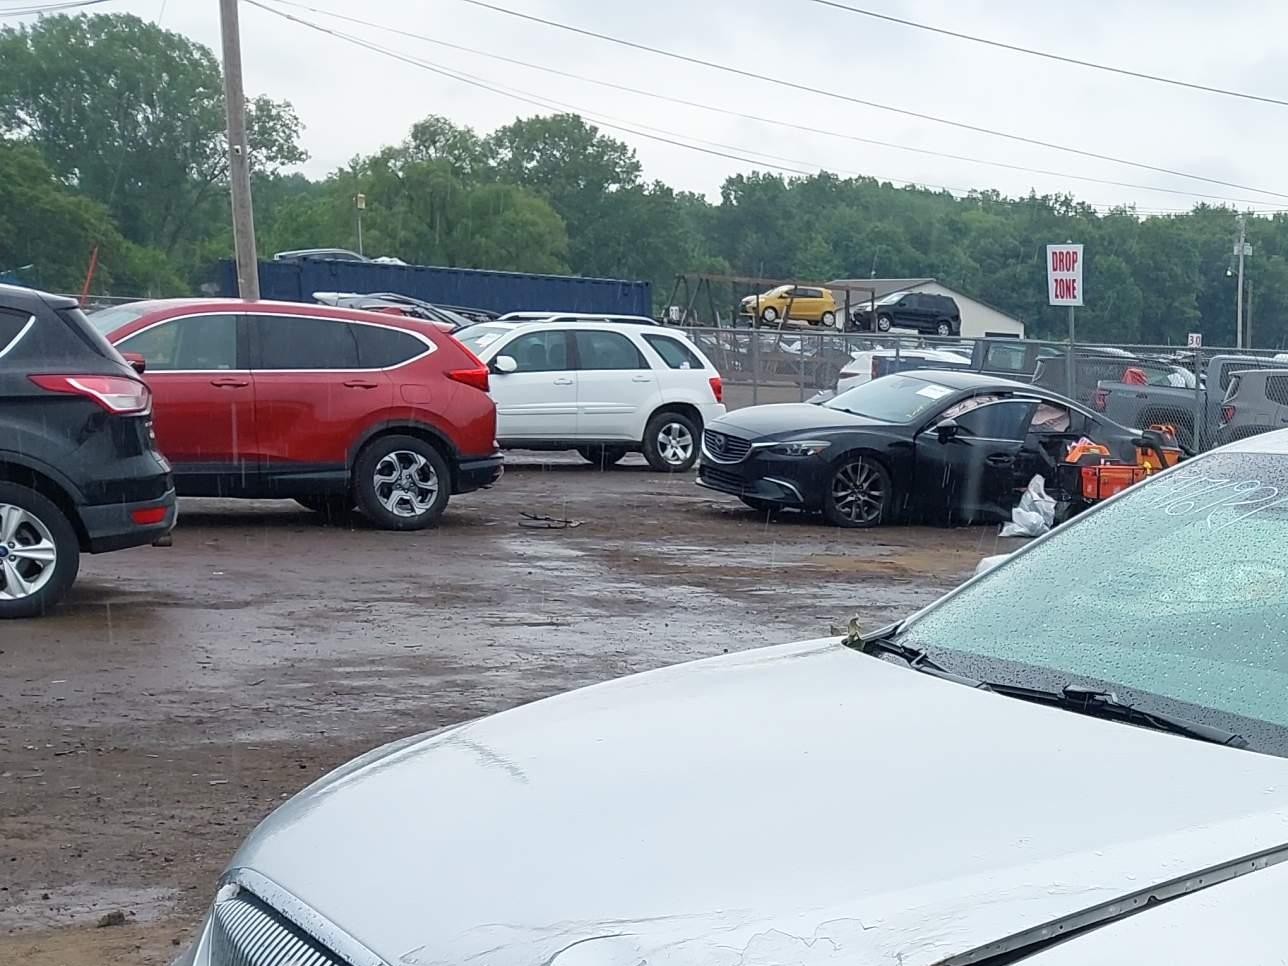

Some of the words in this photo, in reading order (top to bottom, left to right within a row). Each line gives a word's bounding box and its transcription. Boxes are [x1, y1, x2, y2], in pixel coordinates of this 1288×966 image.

[1052, 251, 1078, 272] DROP
[1054, 278, 1077, 299] ZONE
[1190, 336, 1201, 346] 30
